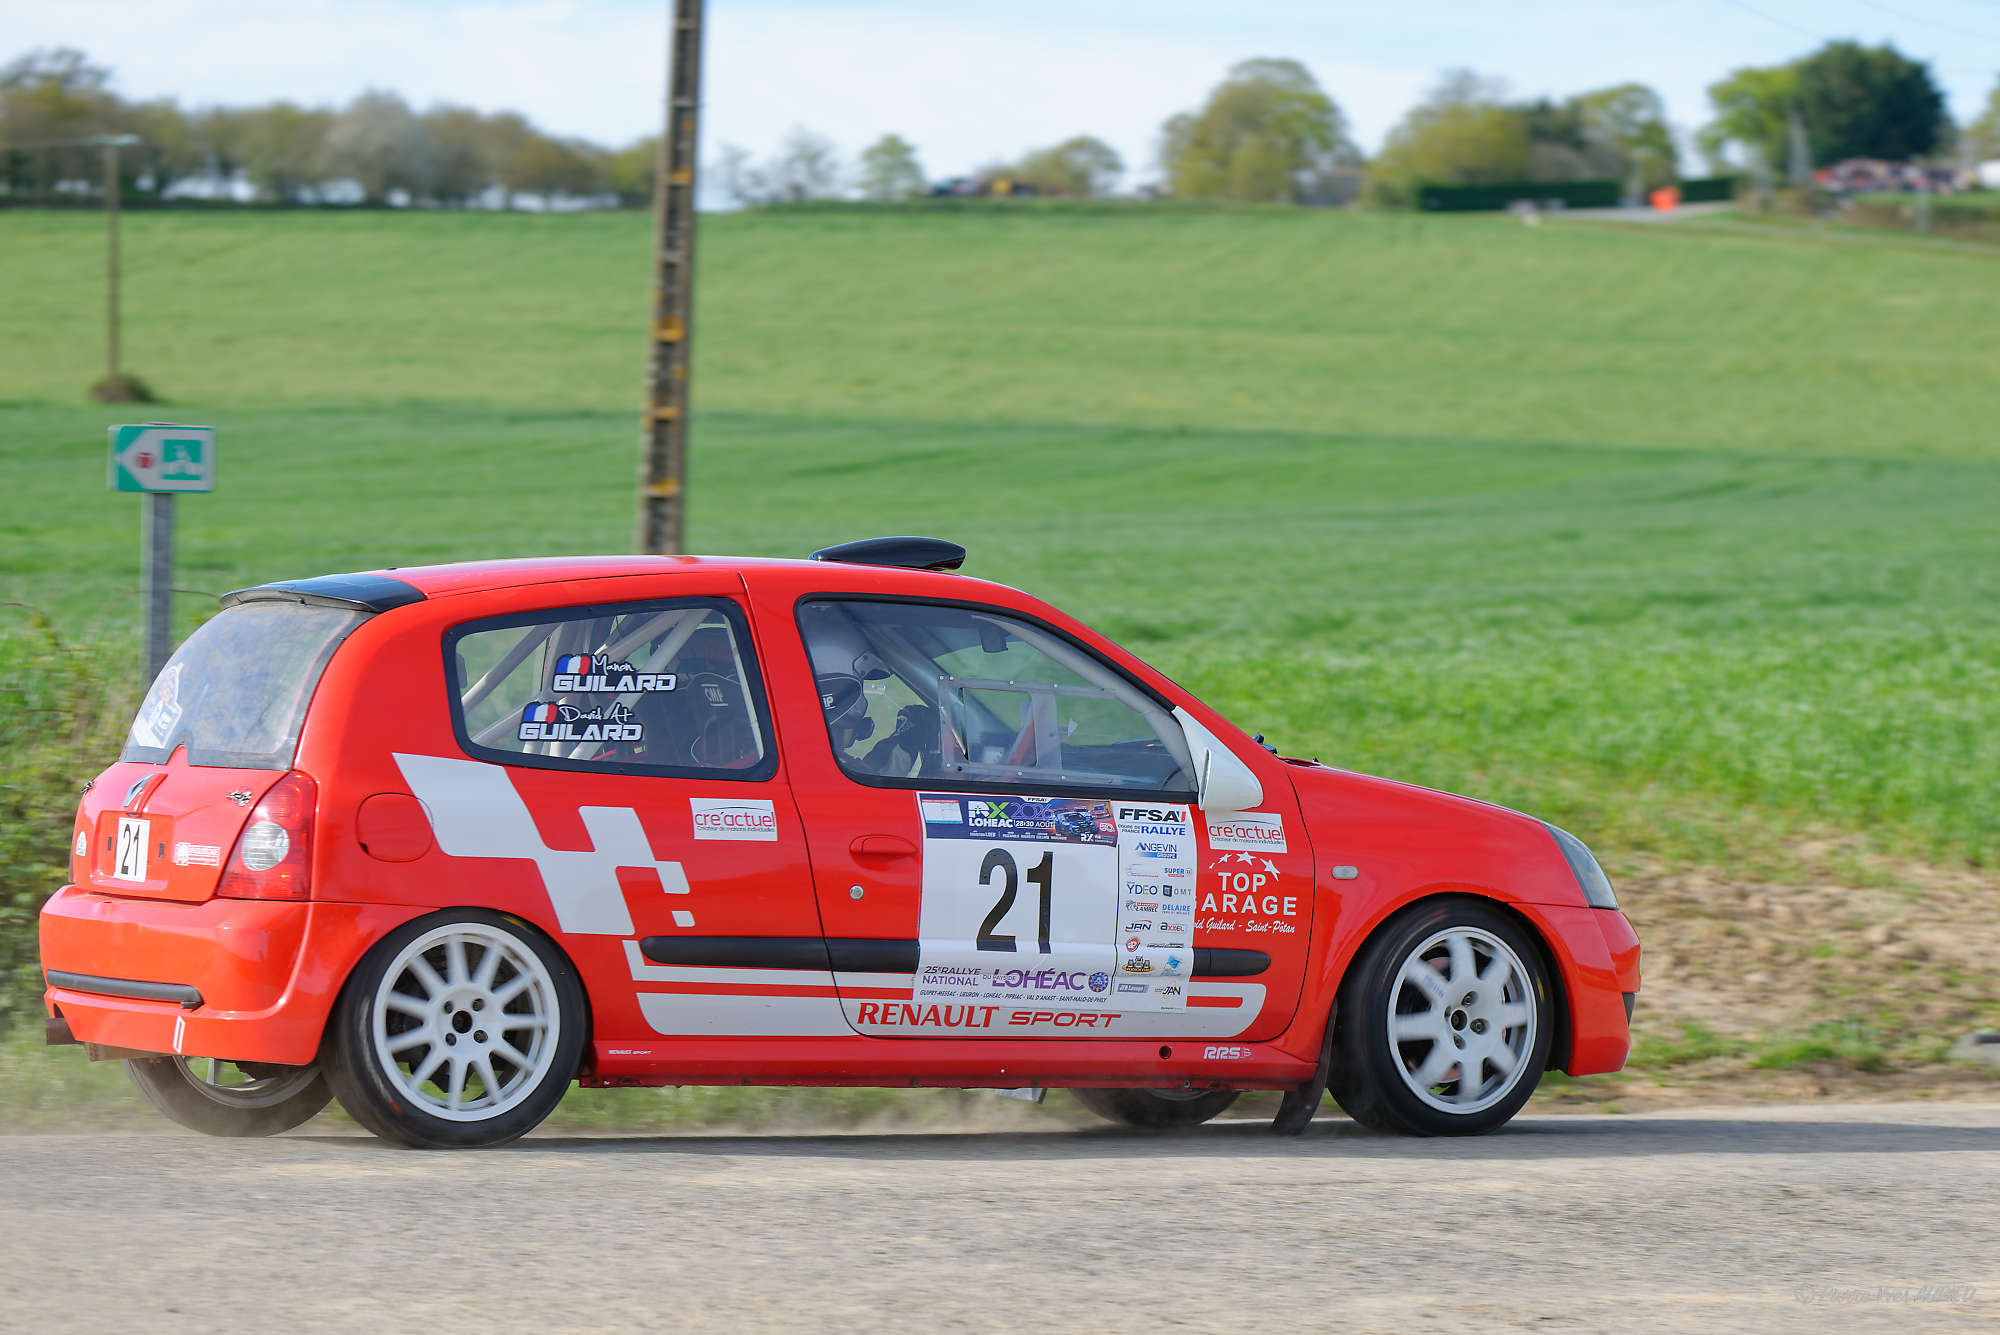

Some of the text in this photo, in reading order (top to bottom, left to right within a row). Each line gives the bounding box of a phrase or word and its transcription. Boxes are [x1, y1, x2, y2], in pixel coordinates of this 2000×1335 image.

[553, 674, 677, 691] GUILARD
[559, 705, 602, 721] David
[519, 723, 642, 740] GUILARD
[968, 800, 1009, 818] RX
[968, 818, 1013, 828] LOHEAC
[1141, 826, 1186, 836] RALLYE
[121, 824, 140, 876] 21
[1135, 842, 1177, 853] ANGEVIN
[1164, 867, 1185, 875] SUPER
[1218, 872, 1266, 893] TOP
[976, 847, 1053, 954] 21
[1162, 904, 1191, 912] DELAIRE
[1196, 893, 1297, 916] ARAGE
[1206, 917, 1236, 934] Guilard
[922, 975, 979, 986] NATIONAL
[992, 968, 1086, 990] LOHÉAC
[1162, 986, 1181, 995] JAN
[857, 1002, 1121, 1028] RENAULT SPORT
